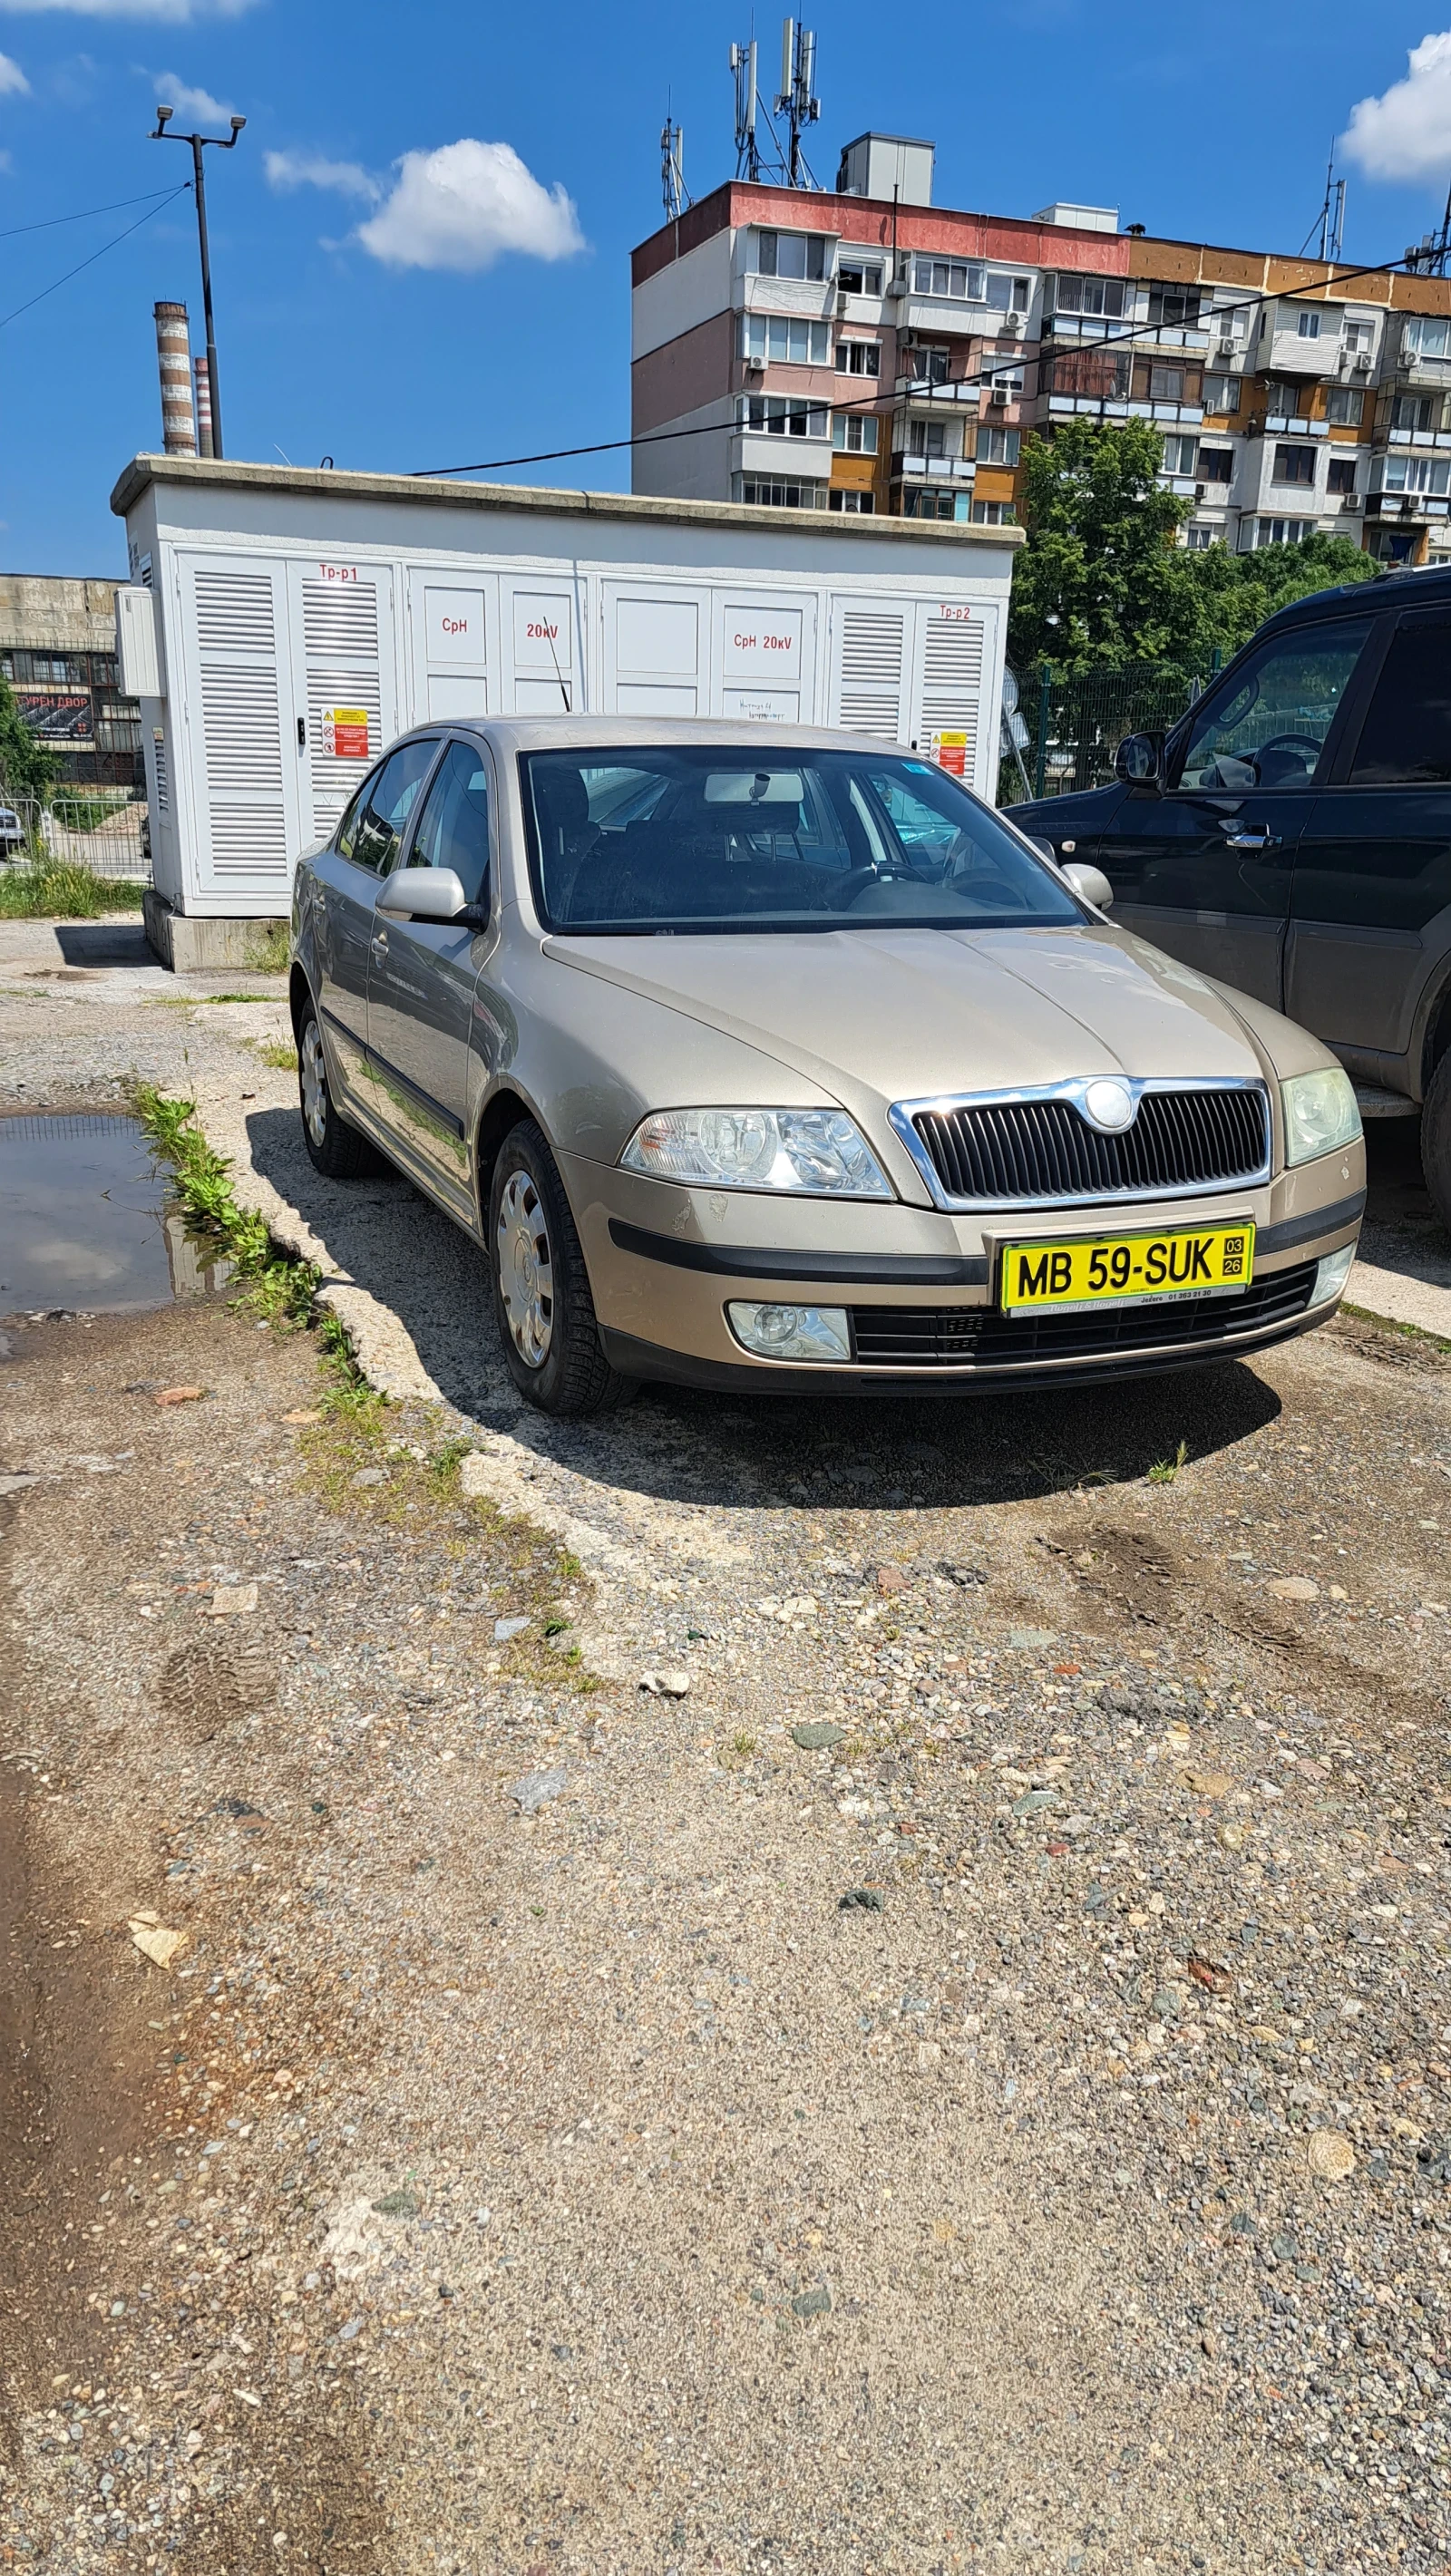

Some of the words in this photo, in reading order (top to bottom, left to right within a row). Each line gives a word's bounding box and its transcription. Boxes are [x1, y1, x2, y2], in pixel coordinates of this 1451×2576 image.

[57, 696, 88, 708] ДВОР
[1226, 1239, 1242, 1253] 03
[1018, 1251, 1072, 1298] MB
[1087, 1237, 1215, 1291] 59-SUK
[1223, 1259, 1241, 1273] 26
[1178, 1291, 1192, 1299] 363
